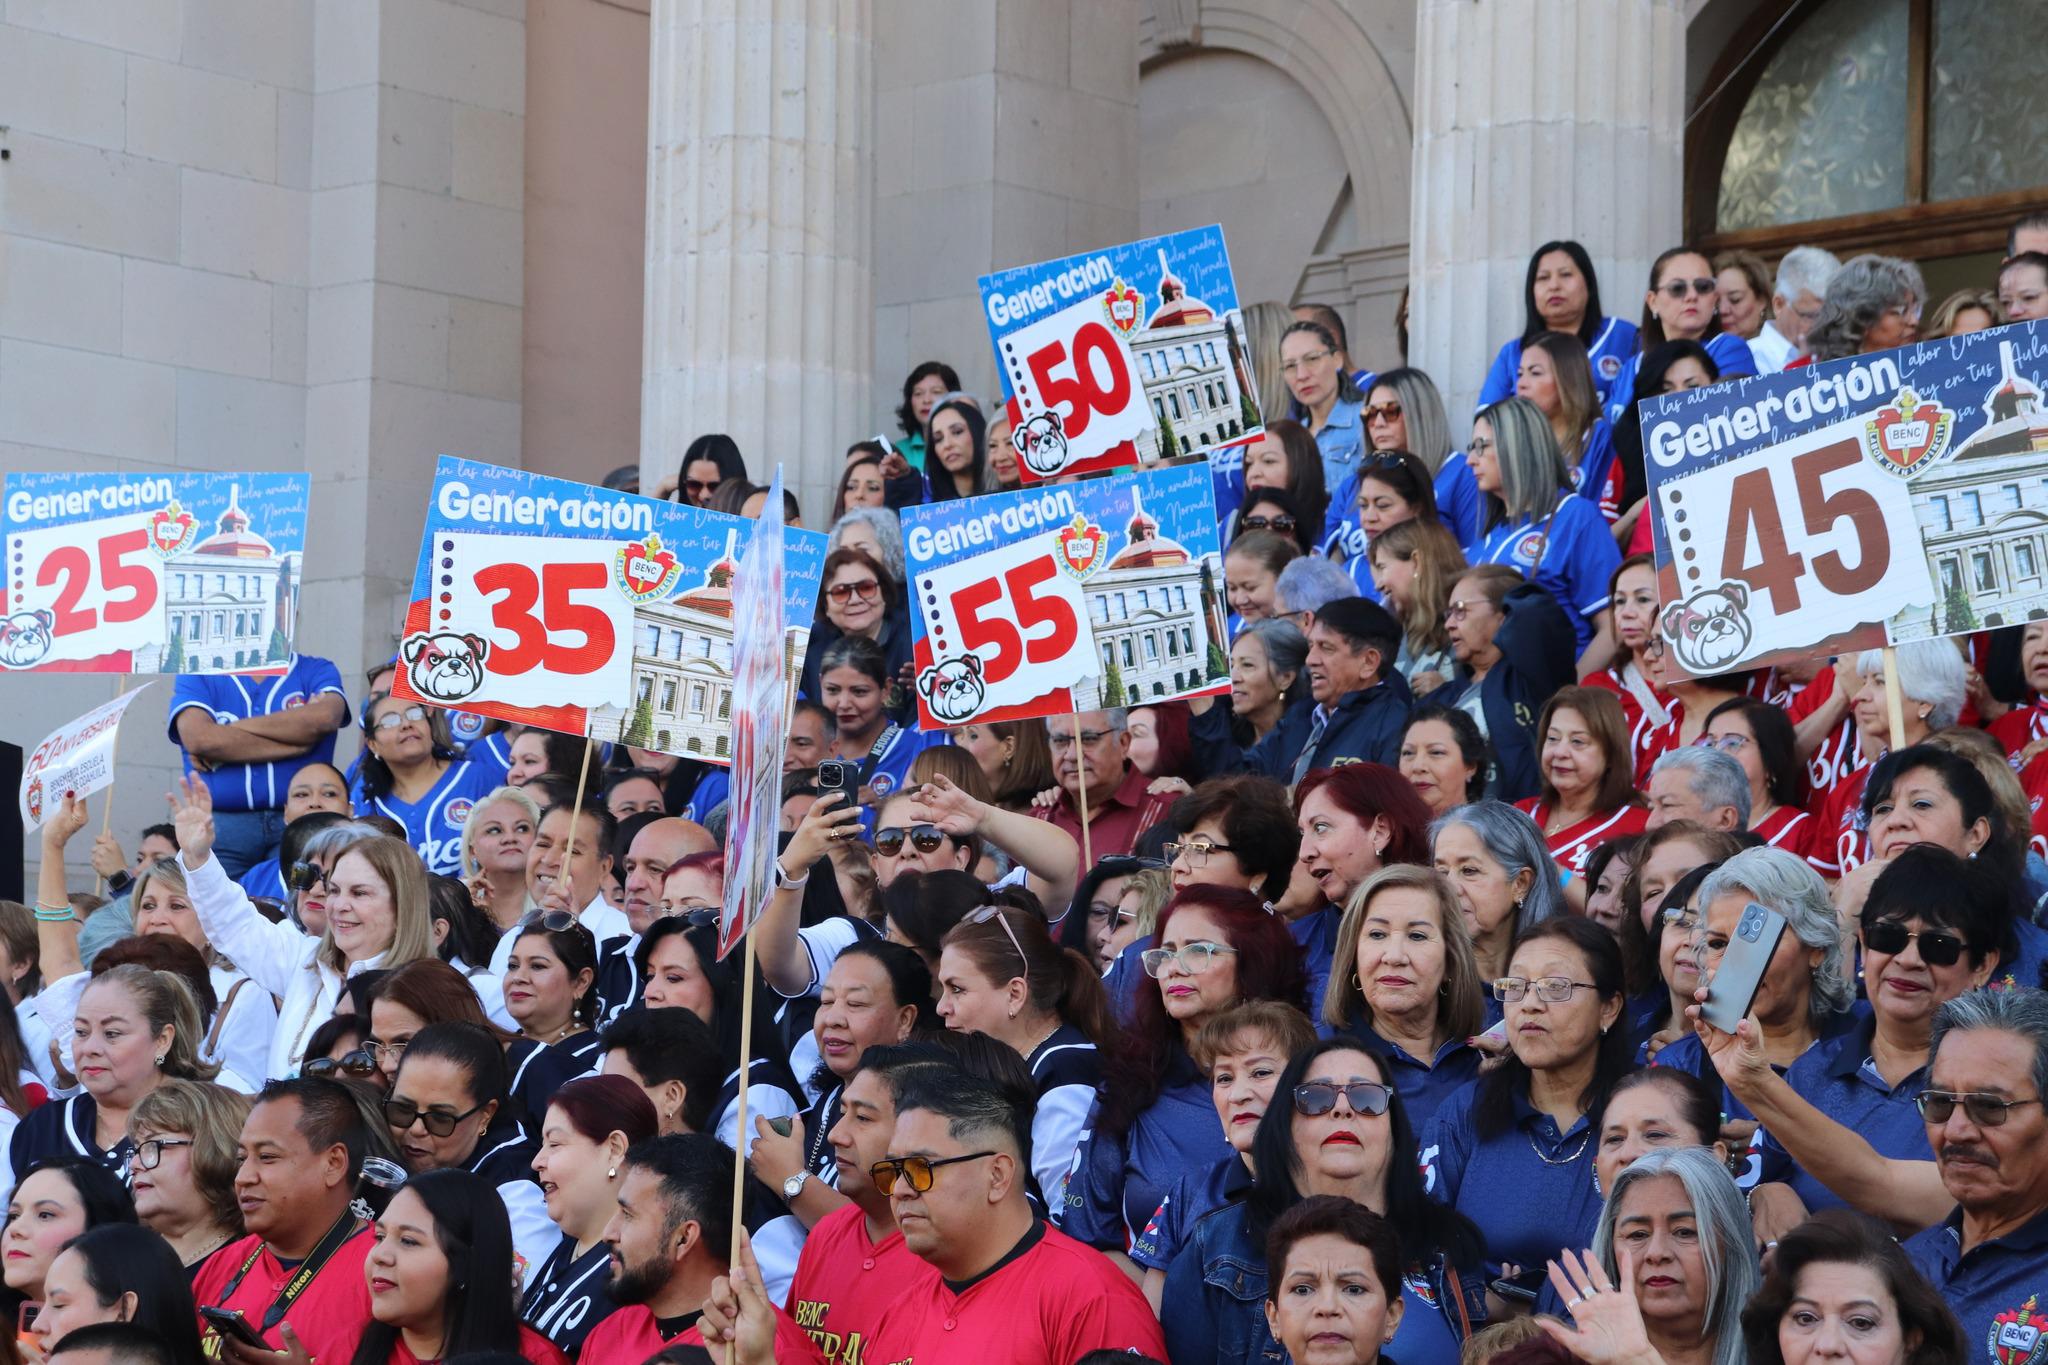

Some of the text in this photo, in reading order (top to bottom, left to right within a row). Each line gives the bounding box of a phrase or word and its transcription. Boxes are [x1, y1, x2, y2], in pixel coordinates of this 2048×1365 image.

[988, 255, 1115, 327] Generación
[1027, 322, 1131, 440] 50
[1898, 342, 1941, 379] Labor
[1944, 376, 1965, 391] en
[1967, 363, 1995, 382] tus
[2011, 334, 2048, 370] Aula
[1650, 357, 1901, 467] Generación
[1659, 395, 1683, 415] las
[1687, 381, 1736, 404] almas
[1869, 424, 1945, 476] LABOR OMNIA VINCIT
[1892, 427, 1921, 440] BENC
[8, 477, 172, 523] Generación
[438, 481, 652, 532] Generación
[653, 503, 688, 527] Labor
[909, 490, 1075, 561] Generación
[1071, 543, 1089, 551] BENC
[1720, 437, 1891, 616] 45
[36, 529, 157, 638] 25
[634, 562, 657, 575] BENC
[473, 562, 616, 676] 35
[950, 554, 1078, 684] 55
[286, 1269, 312, 1299] Nikon
[795, 1299, 831, 1328] BENC
[2004, 1326, 2031, 1342] BENC
